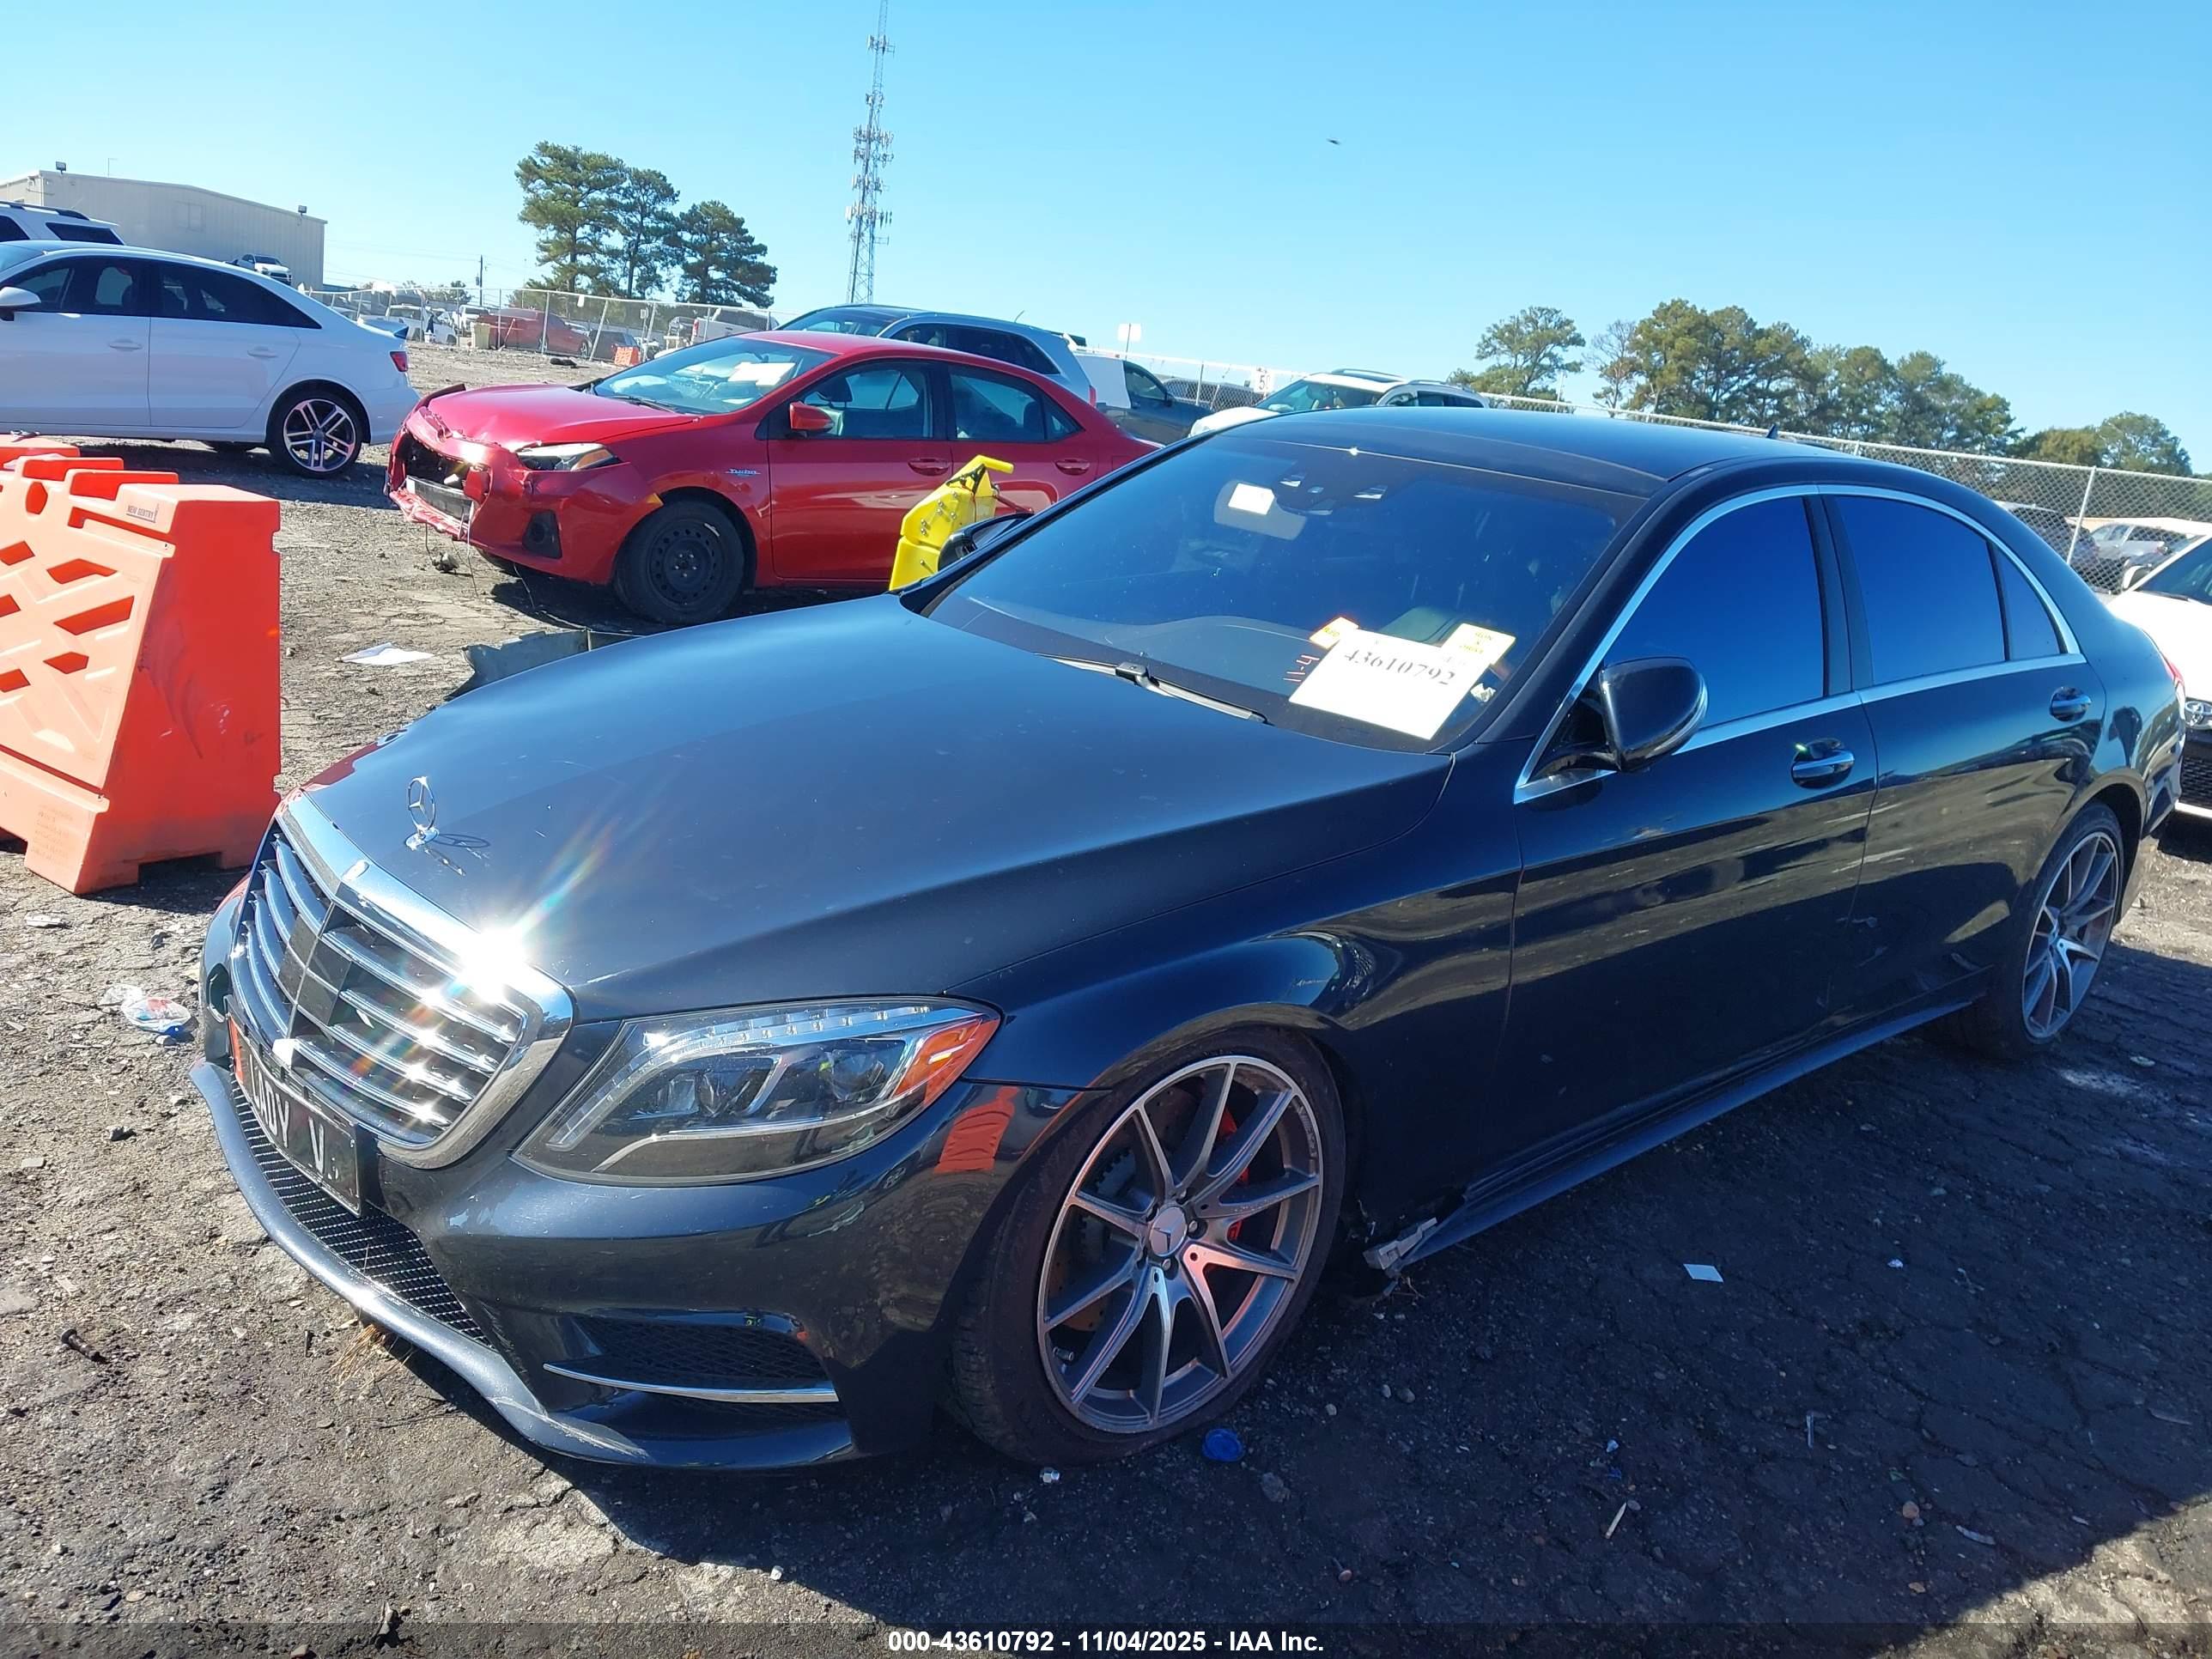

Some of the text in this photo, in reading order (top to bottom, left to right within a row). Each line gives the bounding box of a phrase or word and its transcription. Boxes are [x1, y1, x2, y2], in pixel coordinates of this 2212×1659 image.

[1344, 648, 1455, 685] 43610792
[248, 1054, 325, 1175] LADY V
